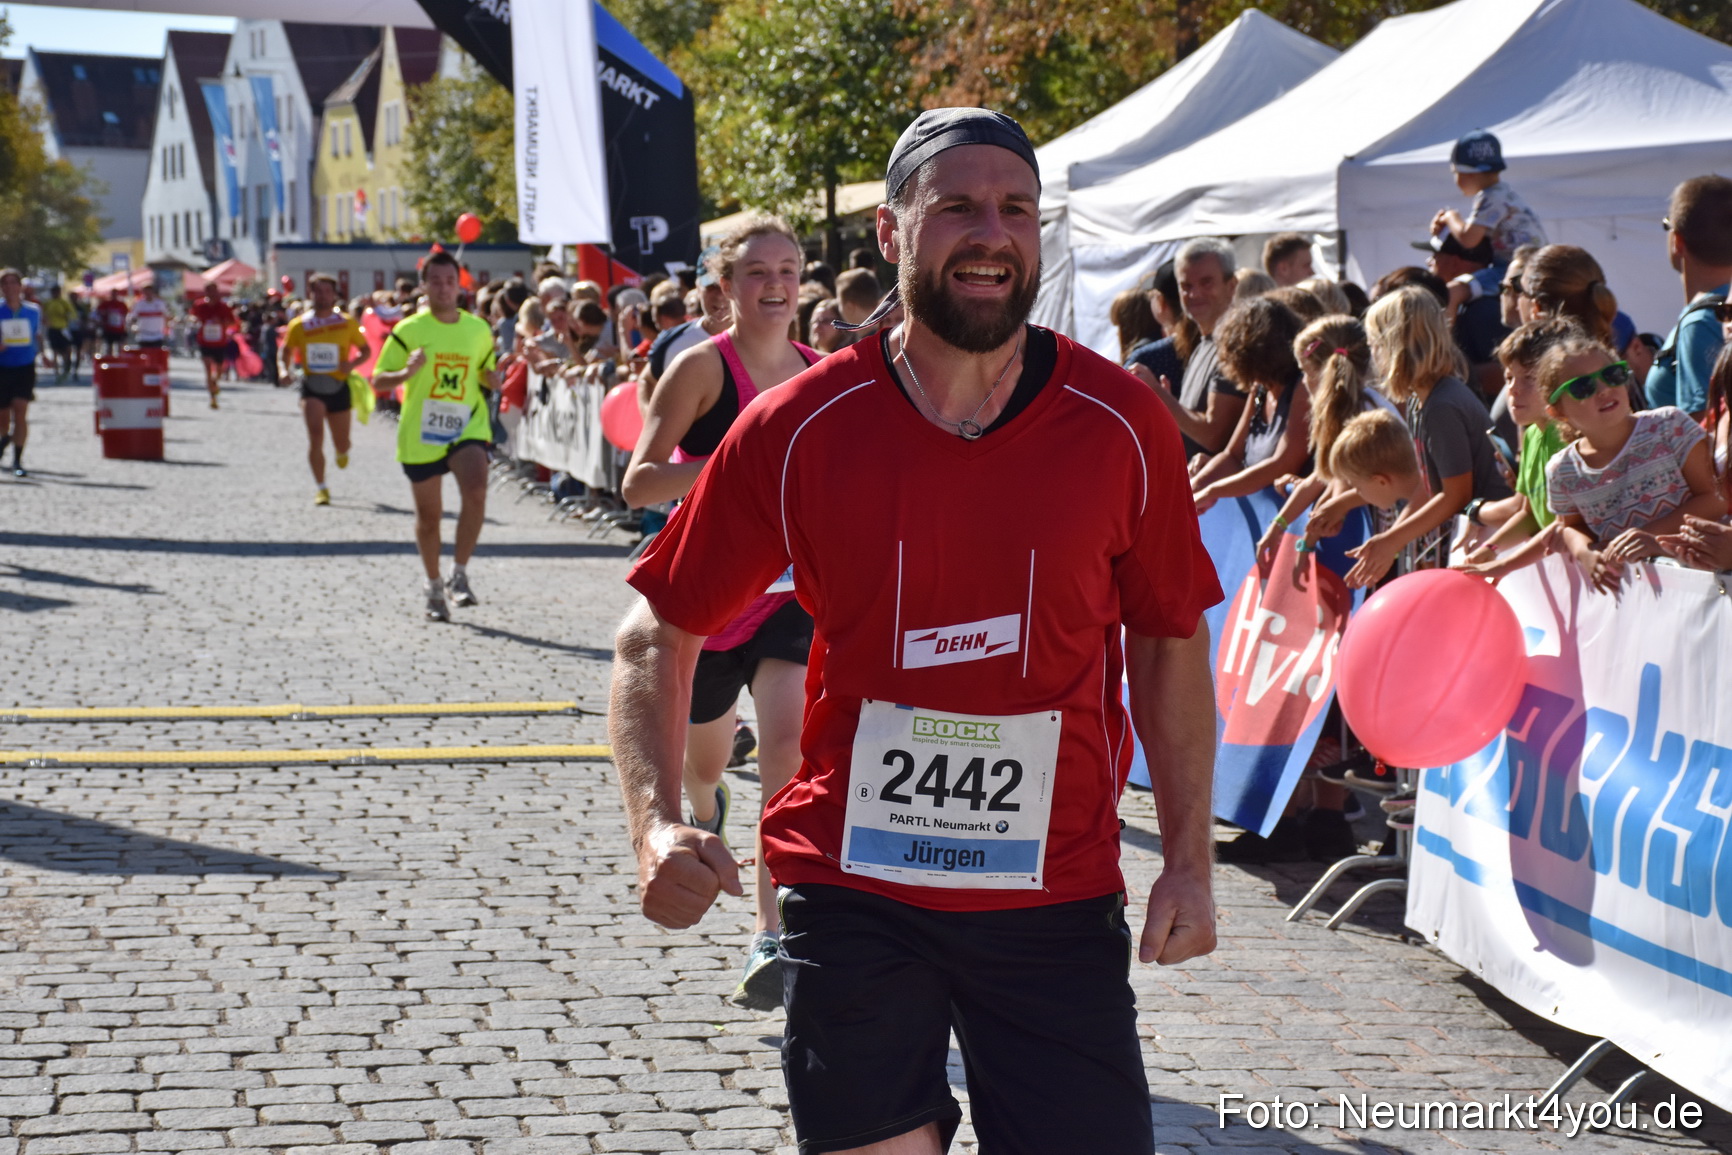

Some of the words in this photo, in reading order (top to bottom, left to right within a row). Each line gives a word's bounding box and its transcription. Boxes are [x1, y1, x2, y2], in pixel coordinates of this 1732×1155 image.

[440, 373, 459, 389] M
[428, 412, 463, 429] 2189
[935, 631, 988, 655] DEHN
[912, 716, 1001, 742] BOCK
[912, 736, 939, 744] inspired
[861, 787, 868, 797] B
[879, 749, 1023, 812] 2442
[889, 813, 930, 827] PARTL
[933, 818, 991, 832] Neumarkt
[904, 840, 985, 870] Jürgen
